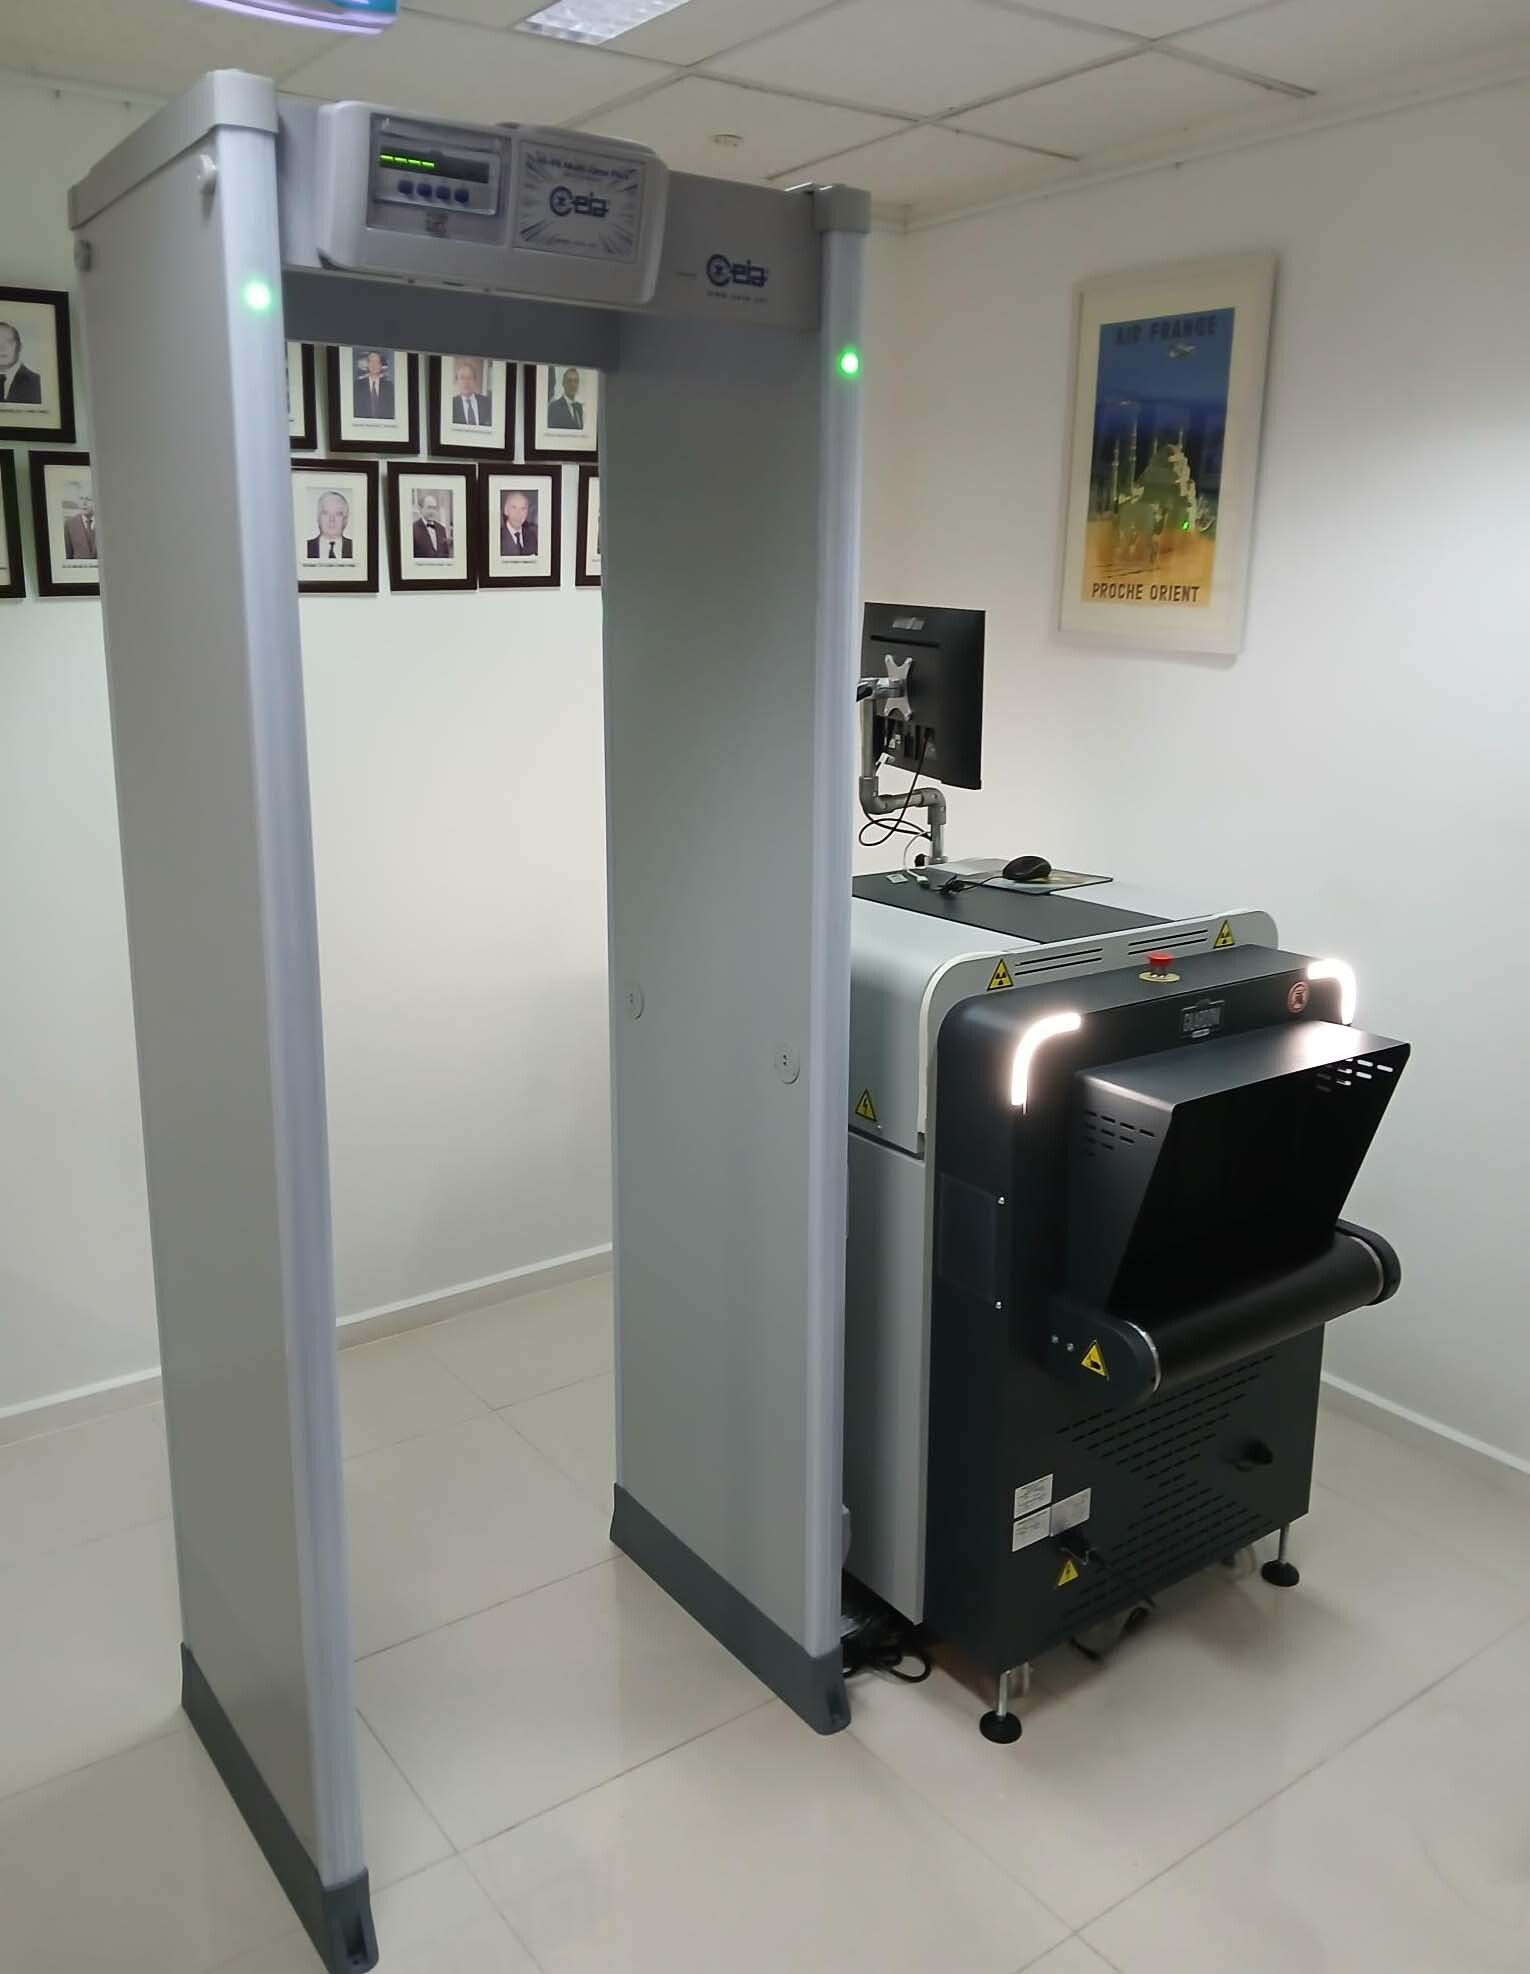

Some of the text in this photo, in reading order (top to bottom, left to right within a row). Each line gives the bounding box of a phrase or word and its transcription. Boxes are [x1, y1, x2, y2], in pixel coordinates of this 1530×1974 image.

[1114, 315, 1217, 345] AIR FRANCE
[1092, 582, 1200, 603] PROCHE ORIENT
